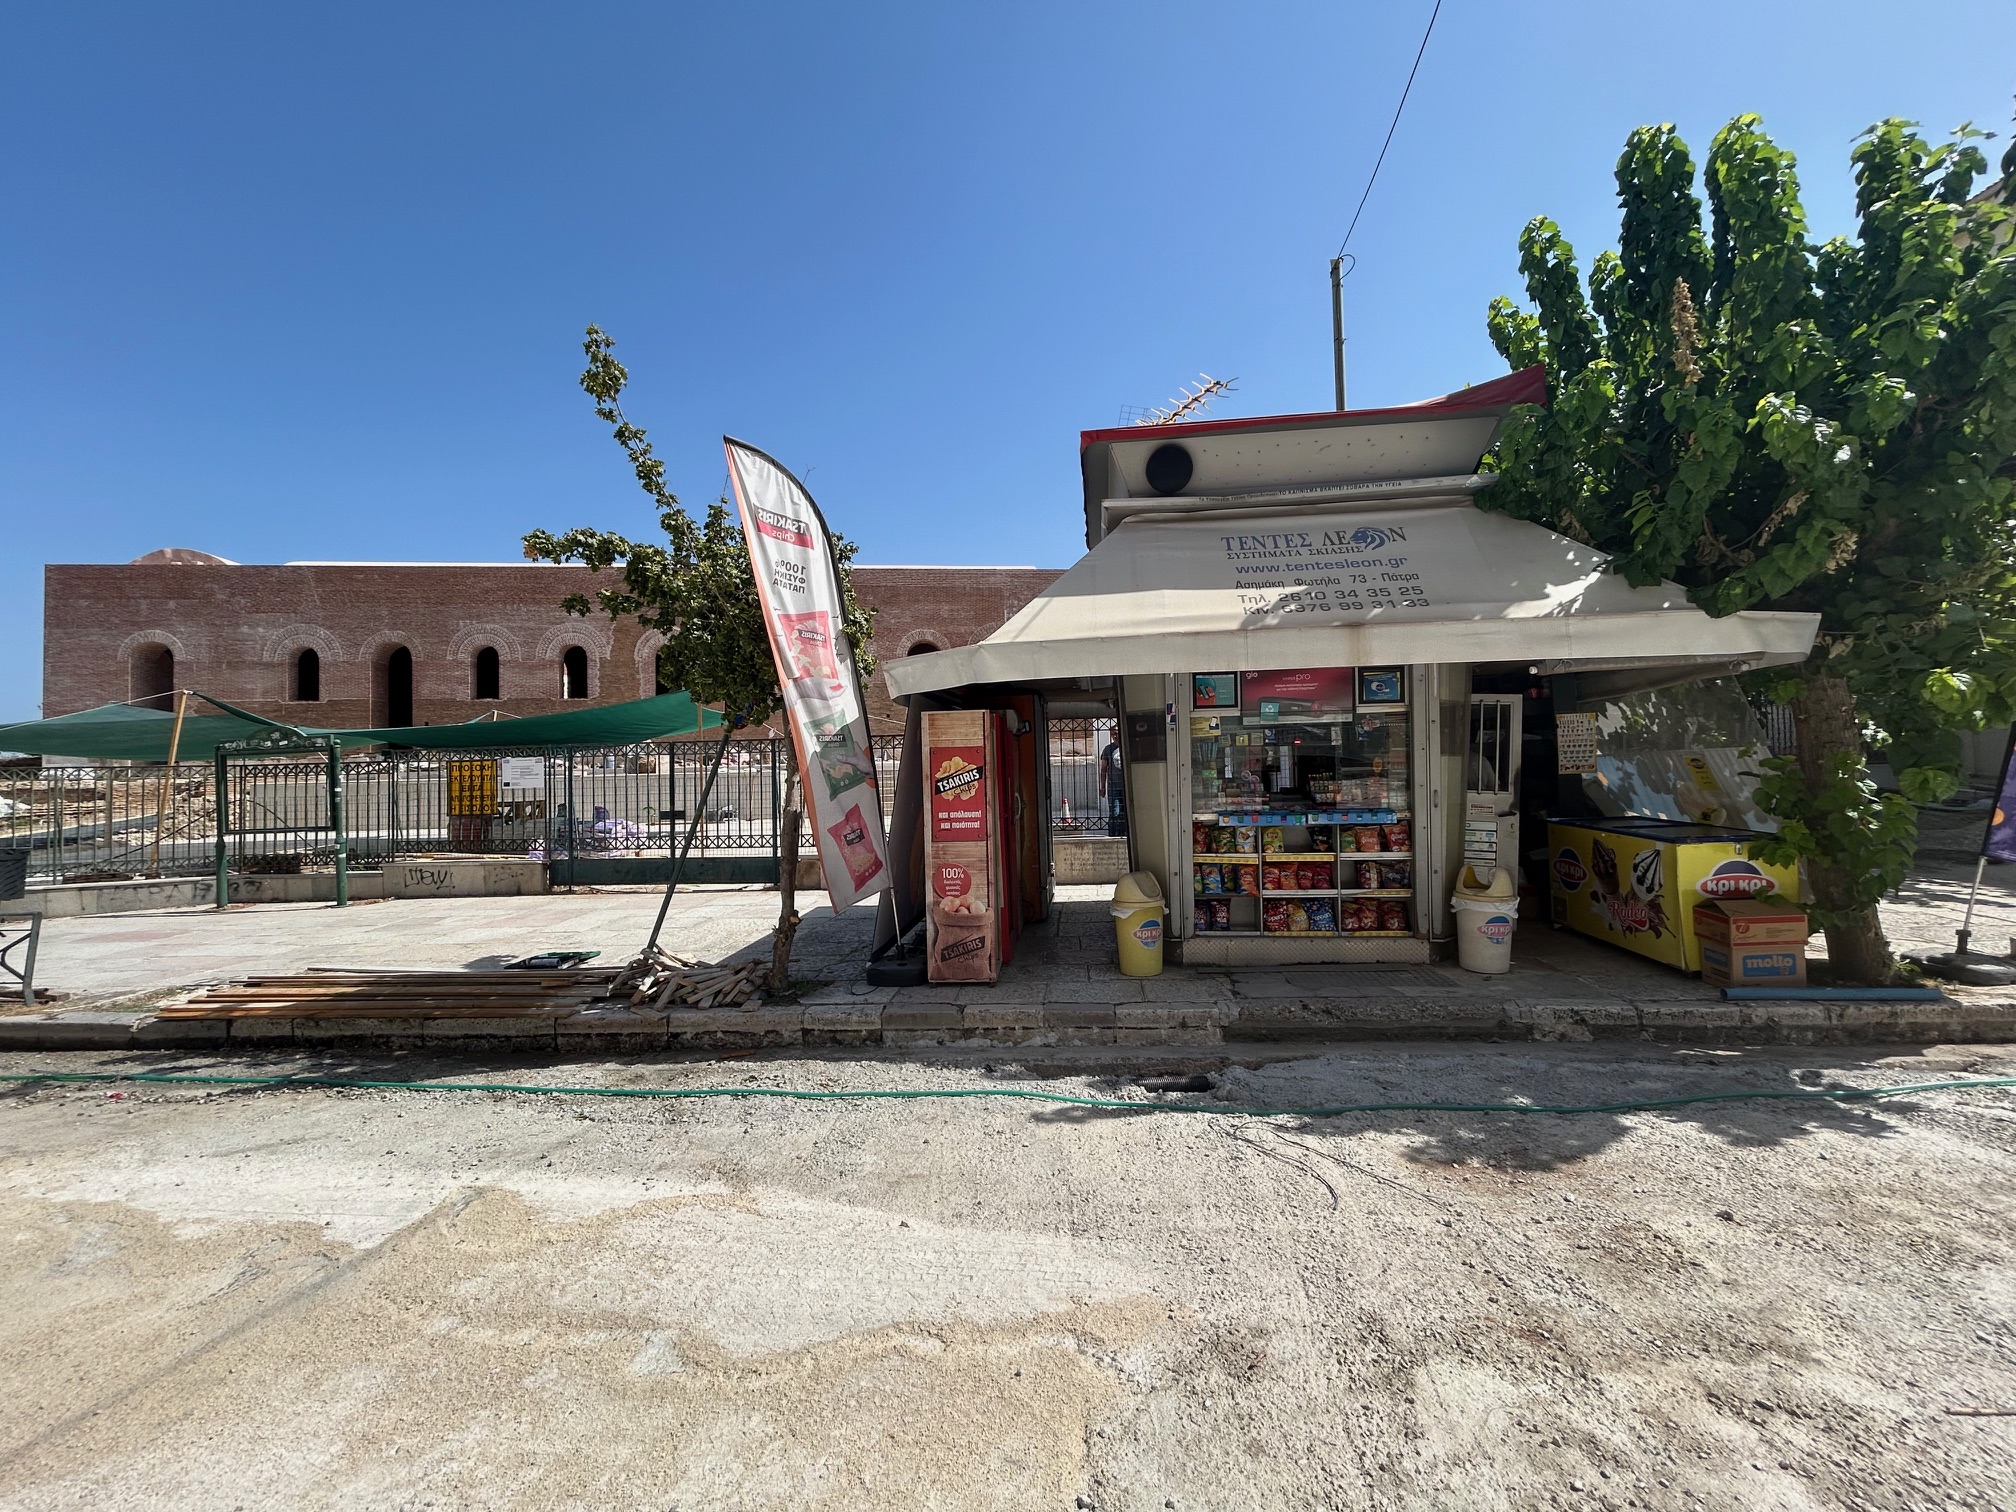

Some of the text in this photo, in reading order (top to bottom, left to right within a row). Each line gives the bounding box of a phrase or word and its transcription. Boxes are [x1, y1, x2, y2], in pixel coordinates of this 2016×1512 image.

[1220, 532, 1312, 551] ΤΕΝΤΕΣ
[1226, 546, 1364, 560] ΣΥΣΤΗΜΑΤΑ ΣΚΙΑΣΗΣ
[1235, 556, 1408, 574] www.tentesleon.gr
[1235, 580, 1286, 590] Ασημάκη
[1294, 576, 1340, 588] Φωτήλα
[1349, 574, 1367, 584] 73
[1381, 572, 1420, 583] Πάτρα
[1237, 586, 1424, 606] Τηλ. 2610 34 35 25
[1243, 598, 1430, 615] Κιν. 6976 99 31 33
[1246, 671, 1258, 680] glo
[1296, 674, 1311, 682] pro
[937, 769, 980, 792] TSAKIRIS
[953, 783, 976, 795] Chips
[942, 868, 964, 878] 100%
[1706, 880, 1734, 895] κρι
[1608, 901, 1646, 926] Rodeo
[1500, 926, 1510, 935] κρ
[943, 939, 982, 959] TSAKIRIS
[1746, 955, 1794, 968] molto
